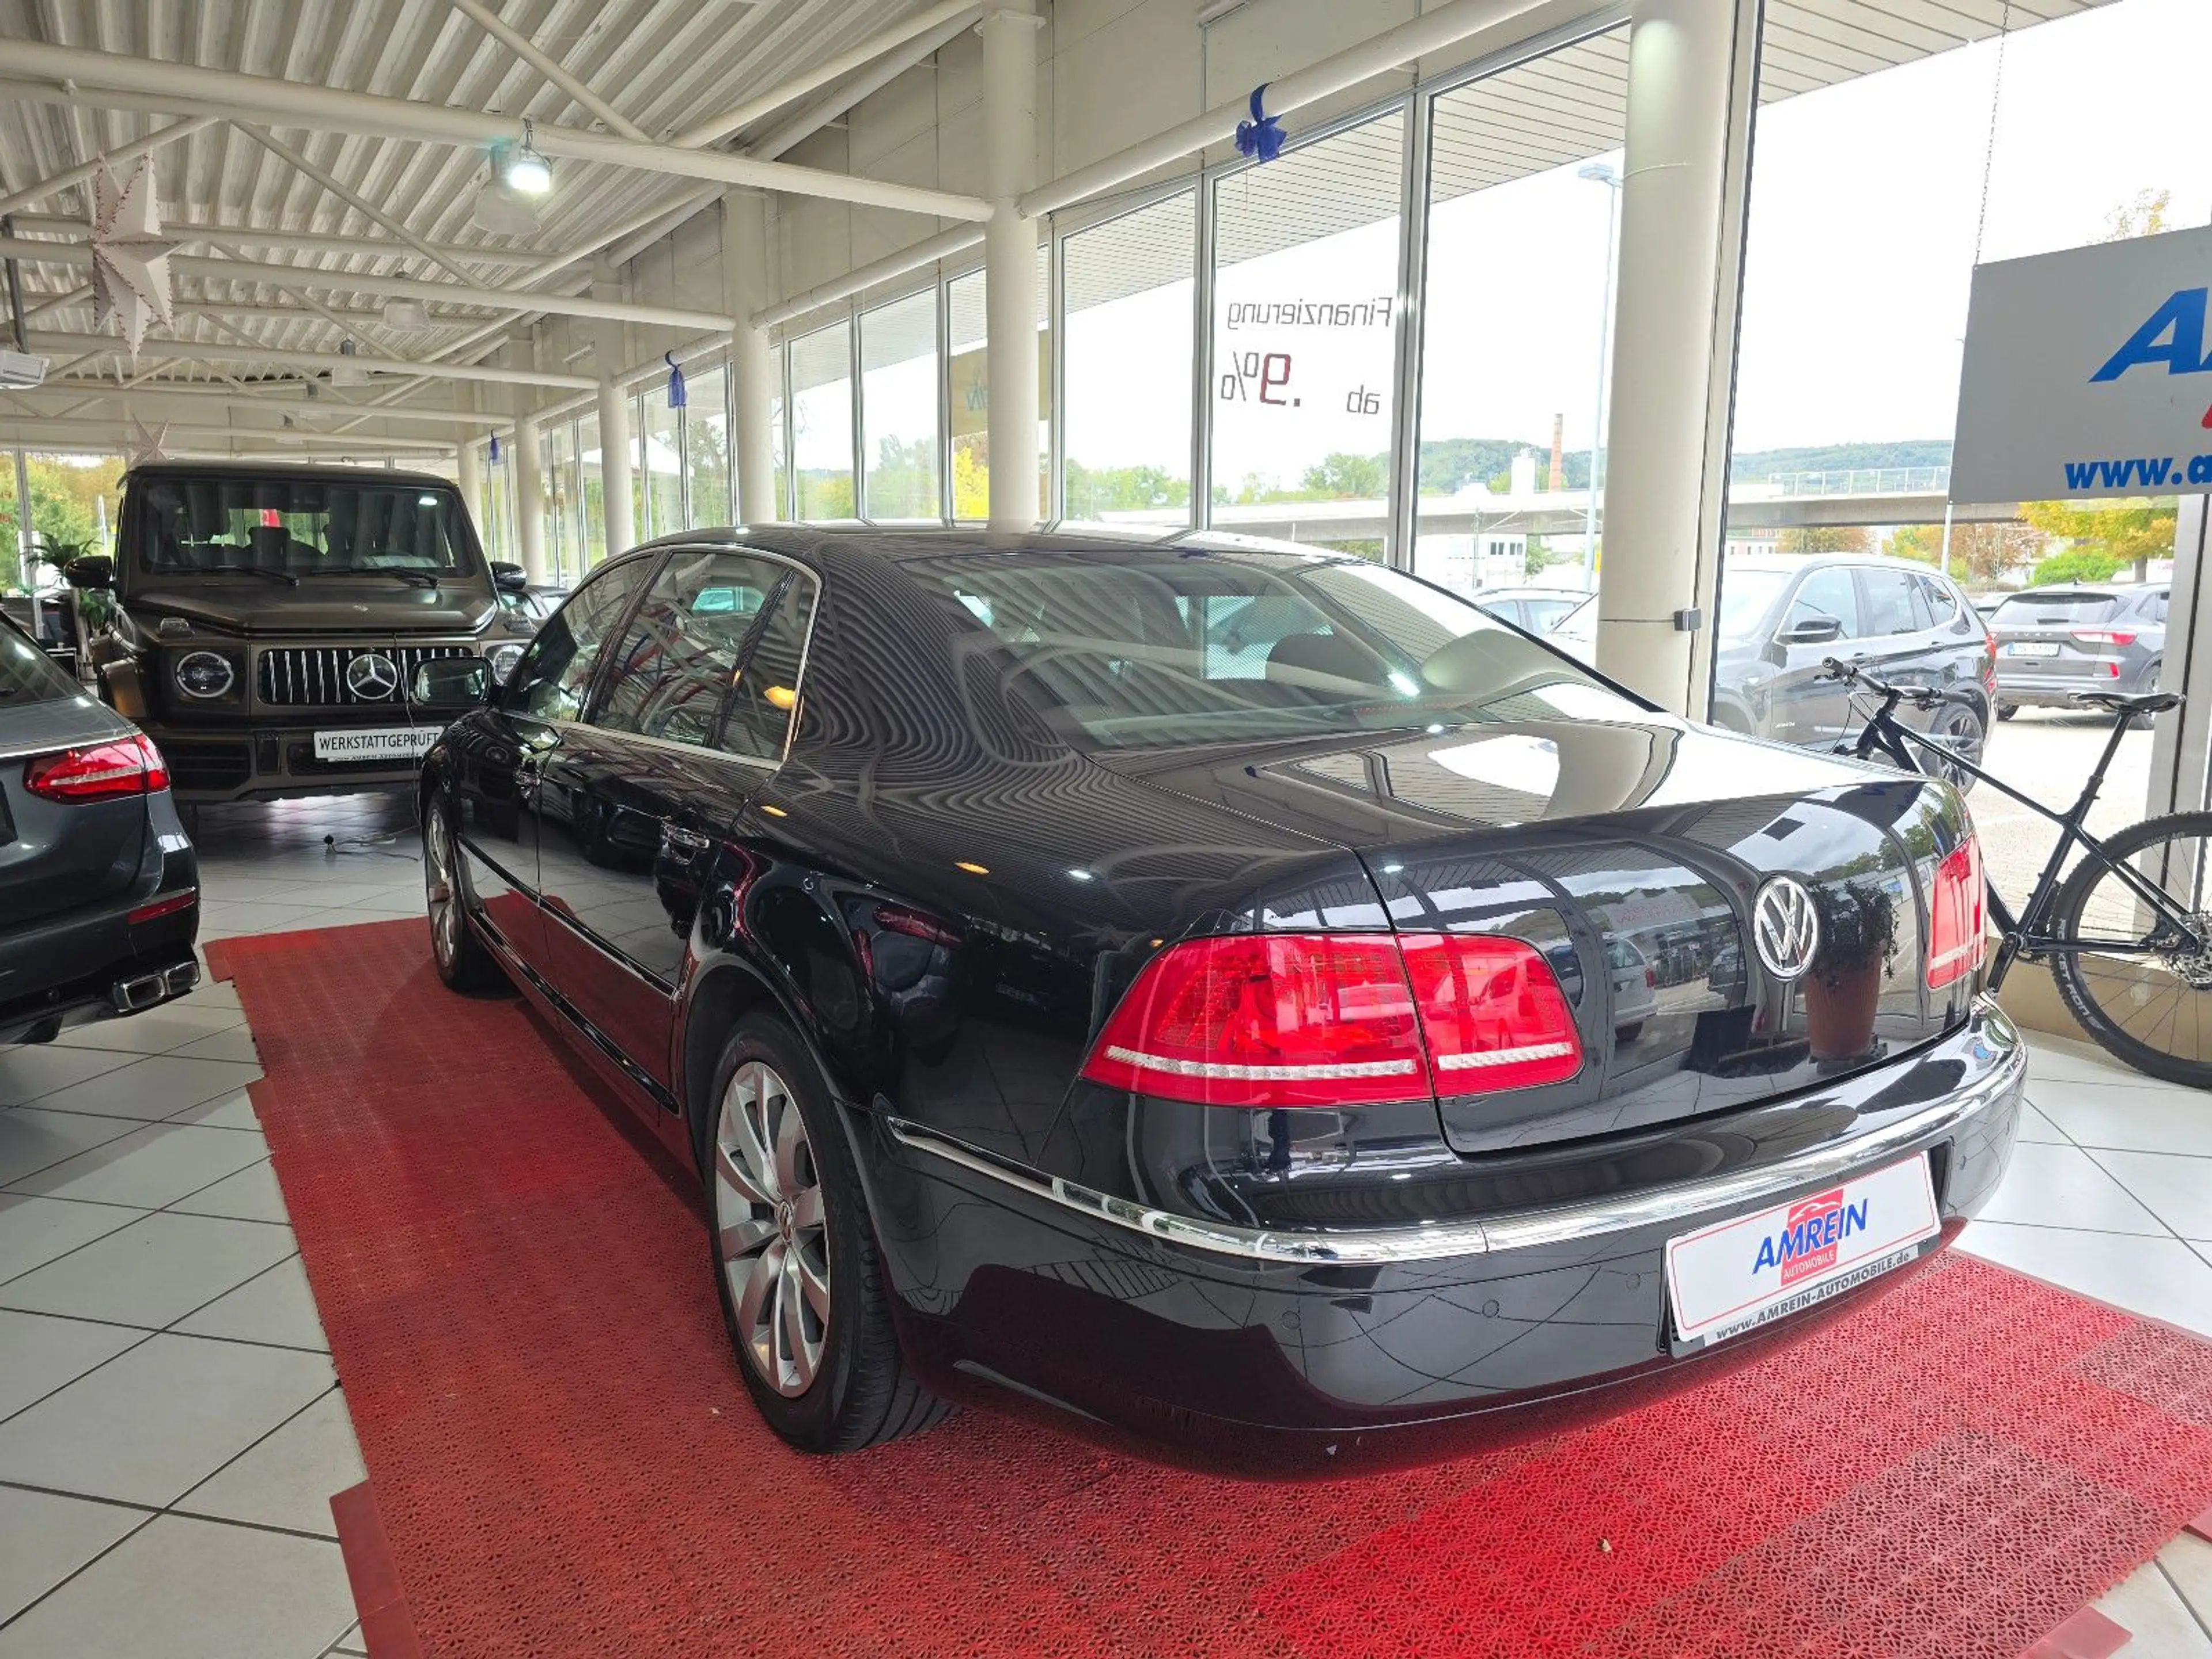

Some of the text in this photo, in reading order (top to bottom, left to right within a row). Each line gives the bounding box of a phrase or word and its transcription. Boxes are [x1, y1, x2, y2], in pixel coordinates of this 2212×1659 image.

[2088, 287, 2212, 381] A
[1752, 1198, 1868, 1275] AMREIN
[1783, 1249, 1835, 1280] AUTOMOBILE
[1716, 1251, 1910, 1339] www.AMREIN-AUTOMOBILE.de
